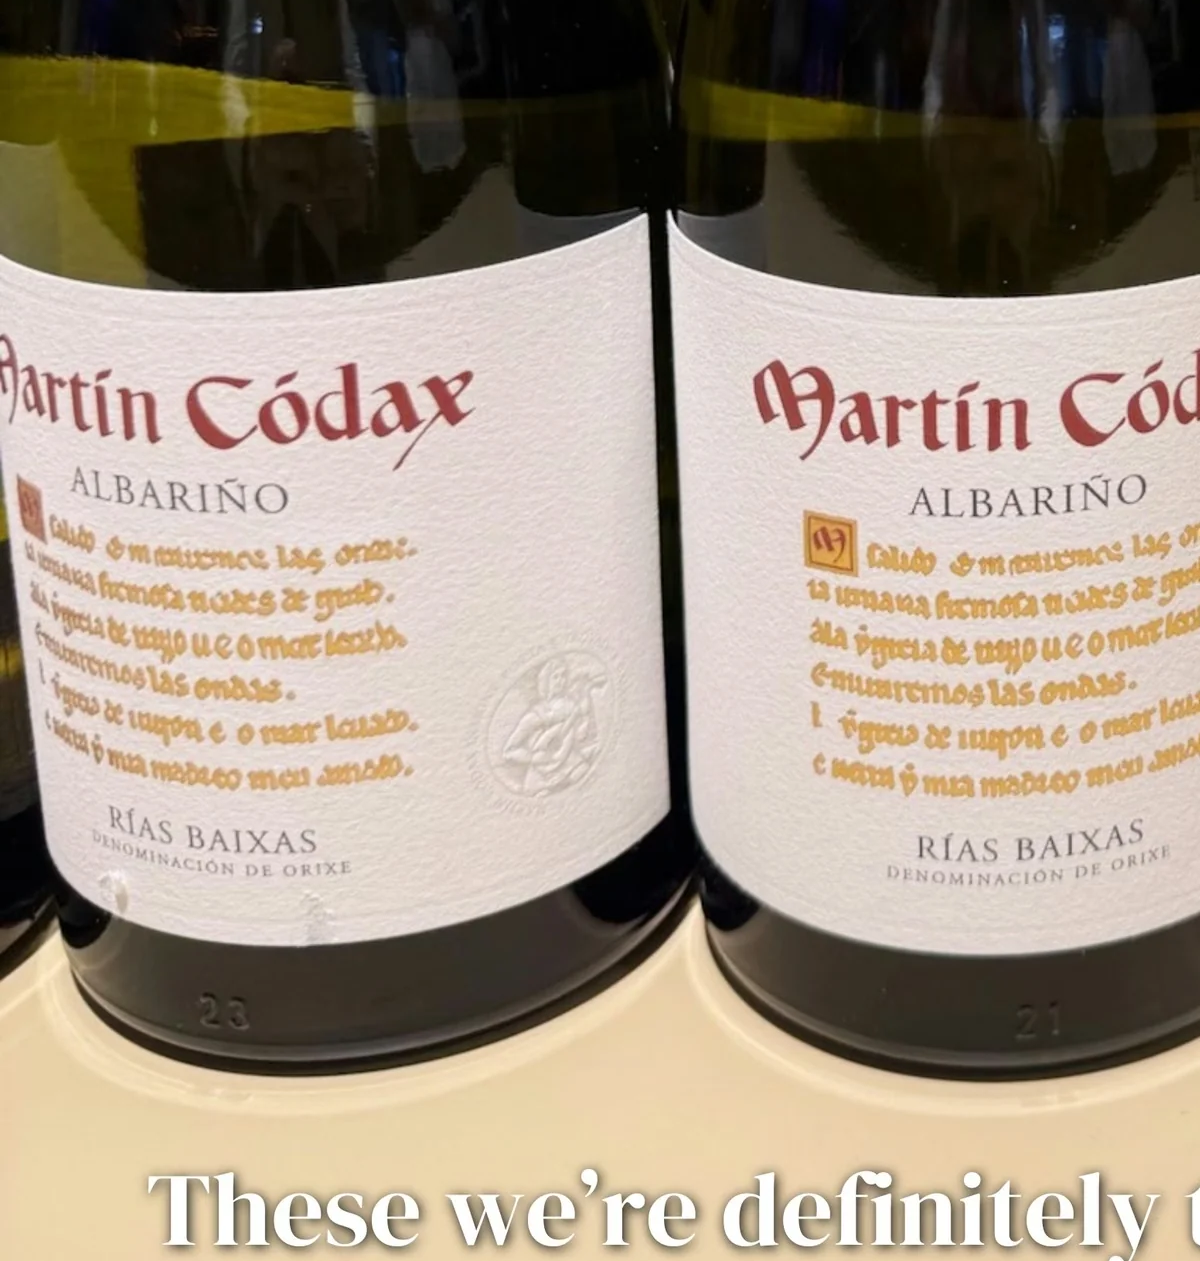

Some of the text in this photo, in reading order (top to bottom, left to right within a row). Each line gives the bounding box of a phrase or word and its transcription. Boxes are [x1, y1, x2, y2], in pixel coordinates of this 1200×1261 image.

[186, 363, 474, 471] Códax
[753, 359, 1032, 461] Martín
[70, 466, 289, 515] ALBARIÑO
[908, 473, 1148, 519] ALBARIÑO
[91, 828, 353, 878] DENOMINACIÓN DE ORIXE
[108, 805, 318, 855] RÍAS BAIXAS
[916, 818, 1145, 863] RÍAS BAIXAS
[886, 843, 1172, 887] DENOMINACIÓN DE ORIXE
